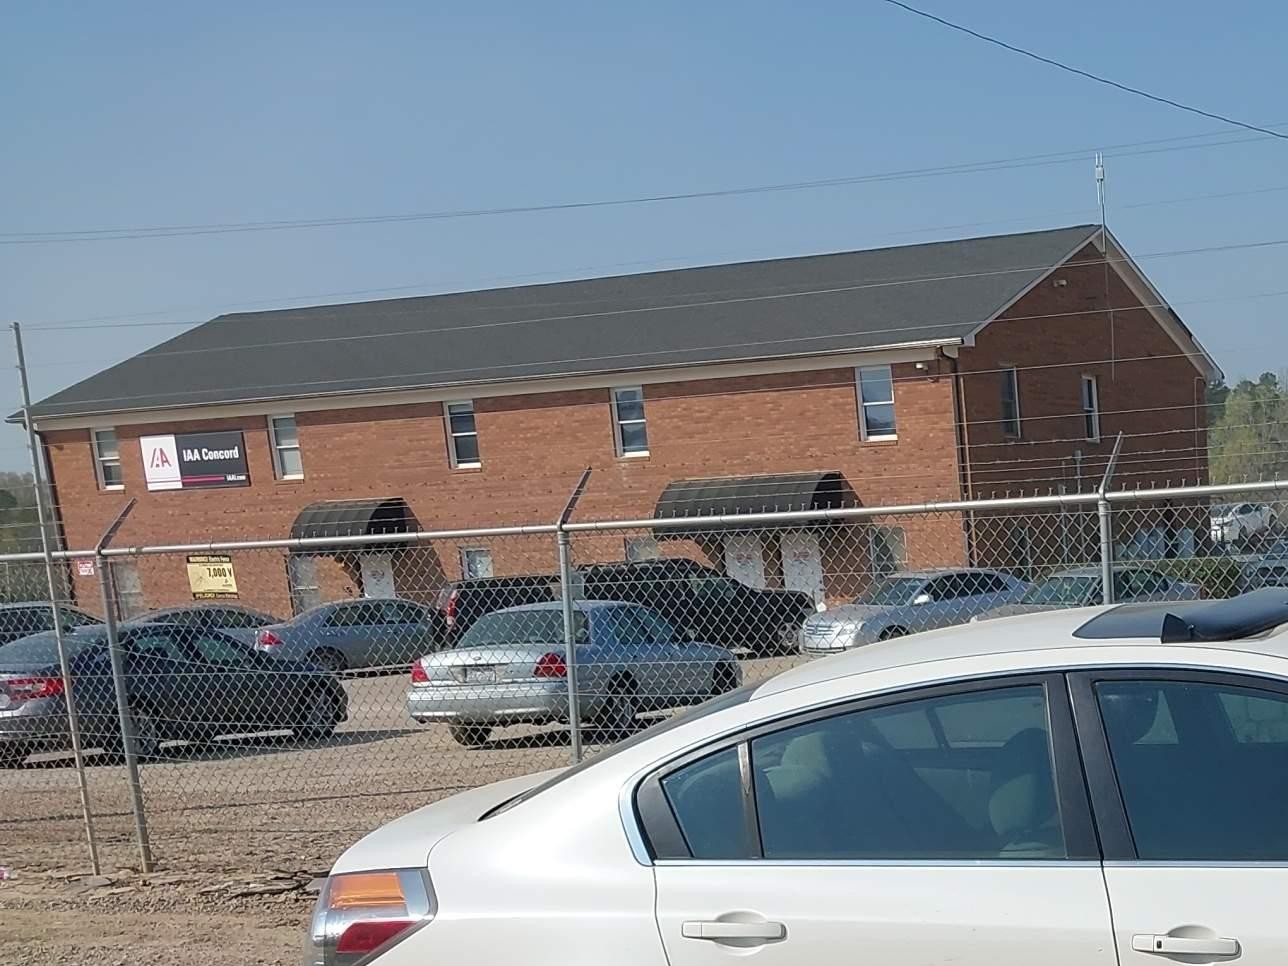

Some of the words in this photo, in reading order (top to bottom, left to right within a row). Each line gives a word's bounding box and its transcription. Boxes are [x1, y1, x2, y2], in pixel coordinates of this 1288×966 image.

[183, 448, 201, 462] IAA
[202, 445, 239, 461] Concord
[206, 567, 227, 579] 7,000
